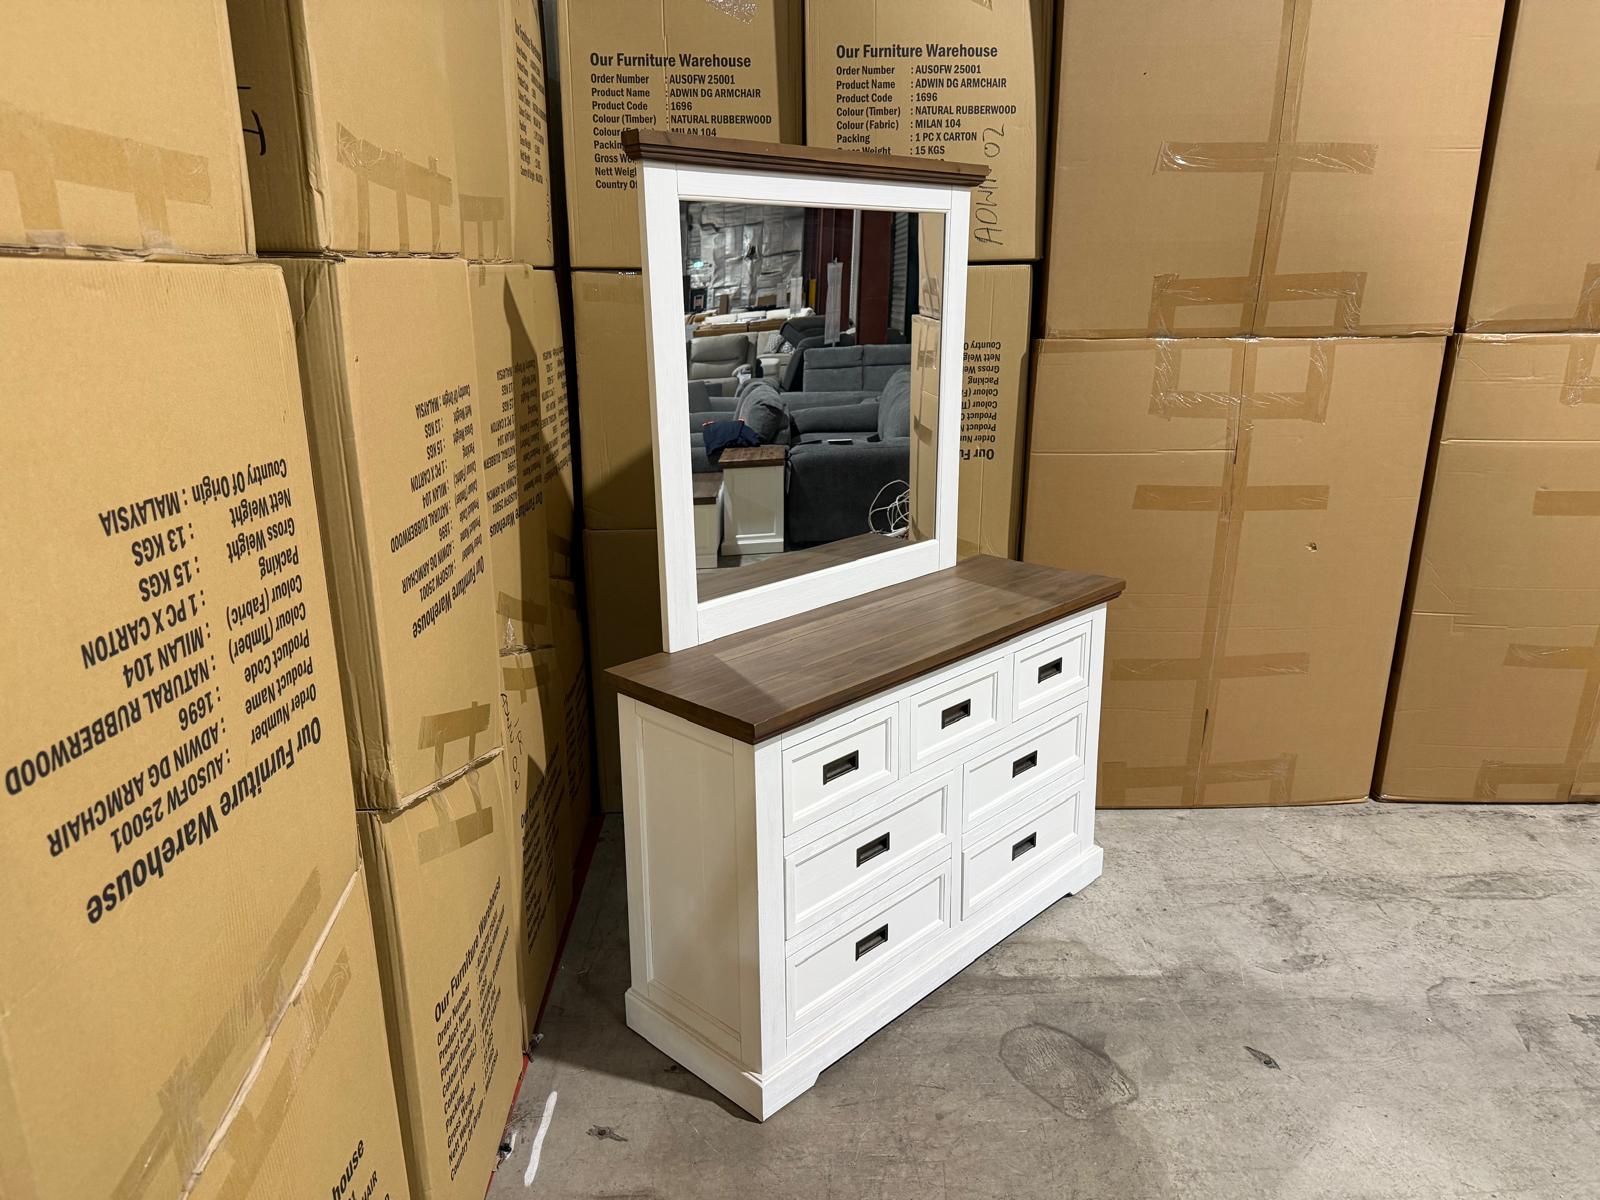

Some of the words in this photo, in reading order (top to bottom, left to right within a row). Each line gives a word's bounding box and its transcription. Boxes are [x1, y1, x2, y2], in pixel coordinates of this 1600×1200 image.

[590, 53, 613, 67] Our
[616, 53, 676, 67] Furniture
[679, 53, 751, 68] Warehouse
[836, 44, 859, 58] Our
[863, 44, 922, 58] Furniture
[926, 43, 998, 57] Warehouse
[590, 73, 614, 84] Order
[616, 74, 649, 84] Number
[669, 74, 707, 85] AUSOFW
[708, 74, 735, 85] 25001
[836, 65, 860, 75] Order
[862, 66, 895, 75] Number
[915, 65, 953, 74] AUSOFW
[954, 64, 981, 73] 25001
[591, 87, 624, 97] Product
[626, 88, 650, 97] Name
[669, 88, 698, 98] ADWIN
[700, 88, 713, 98] DG
[714, 88, 761, 98] ARMCHAIR
[836, 80, 869, 90] Product
[871, 80, 896, 89] Name
[915, 78, 944, 88] ADWIN
[946, 78, 959, 88] DG
[960, 78, 1007, 88] ARMCHAIR
[836, 94, 869, 103] Product
[871, 94, 893, 102] Code
[916, 92, 938, 101] 1696
[592, 101, 625, 110] Product
[626, 101, 648, 110] Code
[671, 101, 692, 111] 1696
[592, 114, 620, 124] Colour
[621, 114, 657, 125] (Timber)
[671, 114, 709, 124] NATURAL
[711, 114, 772, 124] RUBBERWOOD
[836, 107, 864, 117] Colour
[866, 107, 901, 117] (Timber)
[915, 105, 954, 115] NATURAL
[956, 105, 1016, 115] RUBBERWOOD
[593, 127, 621, 137] Colour
[700, 128, 717, 137] 104
[836, 121, 864, 130] Colour
[866, 120, 899, 131] (Fabric)
[915, 119, 942, 129] MILAN
[945, 119, 961, 128] 104
[836, 134, 870, 144] Packing
[915, 132, 921, 141] 1
[922, 132, 934, 141] PC
[936, 132, 942, 141] X
[943, 132, 978, 141] CARTON
[593, 140, 623, 150] Packin
[594, 153, 618, 163] Gross
[915, 146, 926, 155] 15
[928, 146, 945, 155] KGS
[594, 167, 613, 176] Nett
[614, 167, 637, 178] Weig
[595, 180, 627, 191] Country
[970, 341, 1001, 350] Country
[983, 353, 1000, 361] Nett
[968, 375, 999, 385] Packing
[978, 365, 1000, 373] Gross
[972, 400, 997, 408] Colour
[973, 388, 998, 396] Colour
[967, 412, 997, 420] Product
[967, 423, 996, 431] Product
[974, 434, 996, 442] Order
[973, 448, 995, 460] Our
[232, 471, 246, 496] Of
[247, 458, 287, 486] Country
[192, 475, 230, 506] Origin
[268, 487, 292, 513] Nett
[98, 490, 181, 537] MALAYSIA
[229, 497, 269, 528] Weight
[166, 525, 186, 553] 13
[267, 517, 295, 541] Gross
[131, 533, 165, 567] KGS
[226, 529, 267, 564] Weight
[173, 560, 193, 588] 15
[258, 545, 299, 580] Packing
[476, 555, 485, 575] Our
[138, 568, 172, 602] KGS
[272, 574, 303, 603] Colour
[451, 565, 476, 601] Furniture
[166, 599, 187, 628] PC
[188, 593, 198, 617] 1
[226, 587, 270, 632] (Fabric)
[275, 602, 306, 632] Colour
[412, 590, 452, 639] Warehouse
[151, 608, 165, 635] X
[80, 616, 151, 669] CARTON
[157, 626, 205, 670] MILAN
[228, 616, 274, 665] (Timber)
[273, 628, 310, 668] Product
[122, 652, 155, 689] 104
[244, 654, 272, 684] Code
[277, 656, 313, 697] Product
[142, 658, 210, 714] NATURAL
[245, 685, 276, 715] Name
[290, 683, 317, 713] Order
[178, 691, 214, 731] 1696
[250, 702, 290, 745] Number
[5, 697, 142, 796] RUBBERWOOD
[172, 722, 219, 772] ADWIN
[296, 716, 322, 753] Our
[147, 755, 172, 788] DG
[166, 752, 224, 815] AUSOFW
[219, 738, 295, 817] Furniture
[46, 771, 145, 858] ARMCHAIR
[110, 797, 165, 853] 25001
[86, 805, 219, 924] Warehouse
[435, 990, 450, 1022] Our
[450, 934, 478, 997] Furniture
[331, 1139, 365, 1200] house
